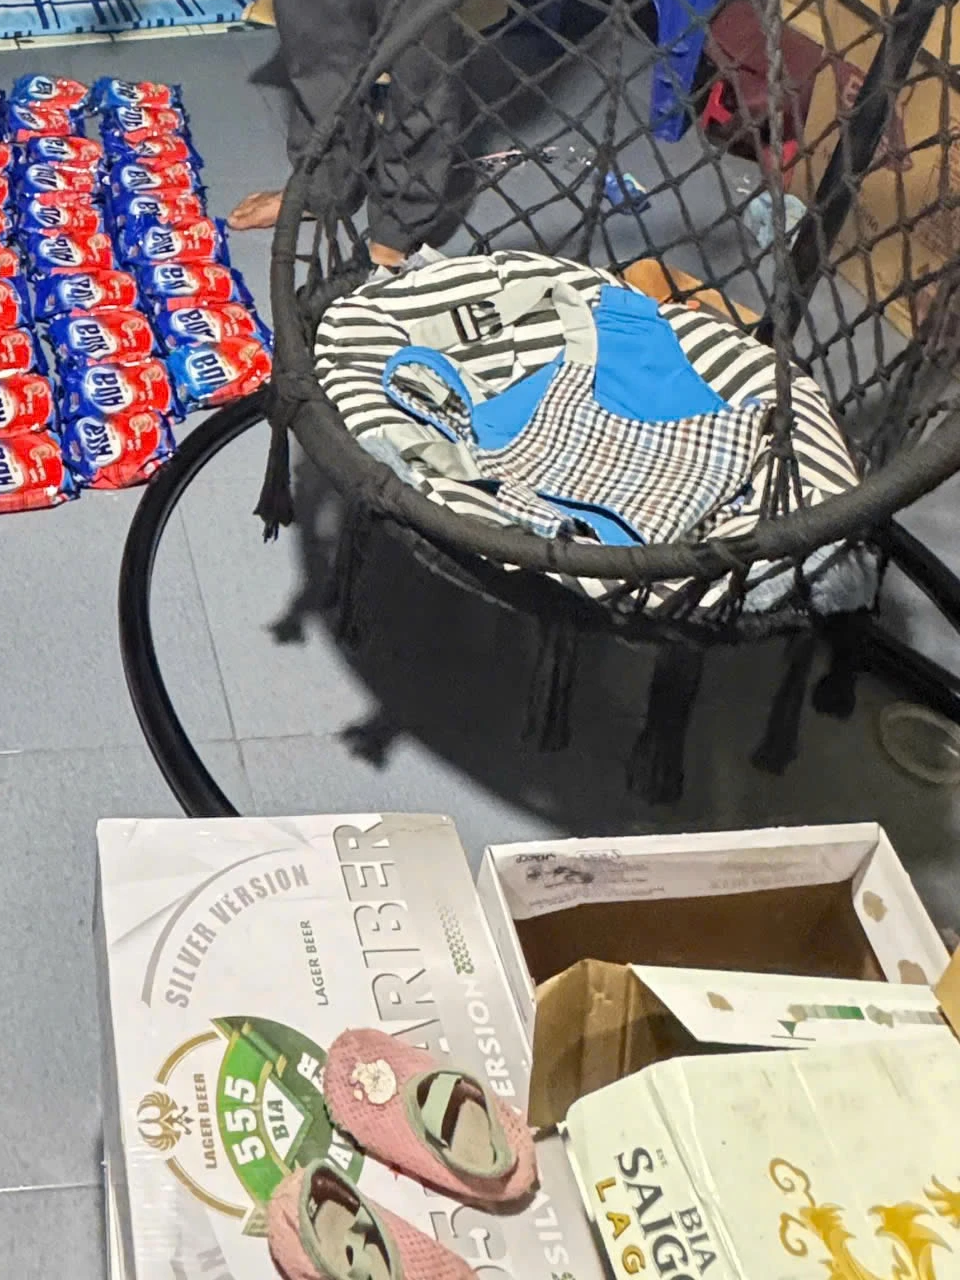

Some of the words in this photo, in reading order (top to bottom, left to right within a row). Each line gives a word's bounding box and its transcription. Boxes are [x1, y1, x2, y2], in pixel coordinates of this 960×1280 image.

[91, 371, 125, 408] Aba
[165, 924, 217, 1009] SILVER
[208, 863, 310, 925] VERSION
[299, 920, 317, 954] BEER
[308, 953, 329, 1006] LAGER
[464, 978, 519, 1104] ERSION
[192, 1072, 211, 1116] BEER
[225, 1076, 266, 1165] 555
[271, 1098, 289, 1140] BIA
[201, 1121, 218, 1169] LAGER
[614, 1147, 696, 1280] SAIG
[678, 1206, 718, 1276] BIA
